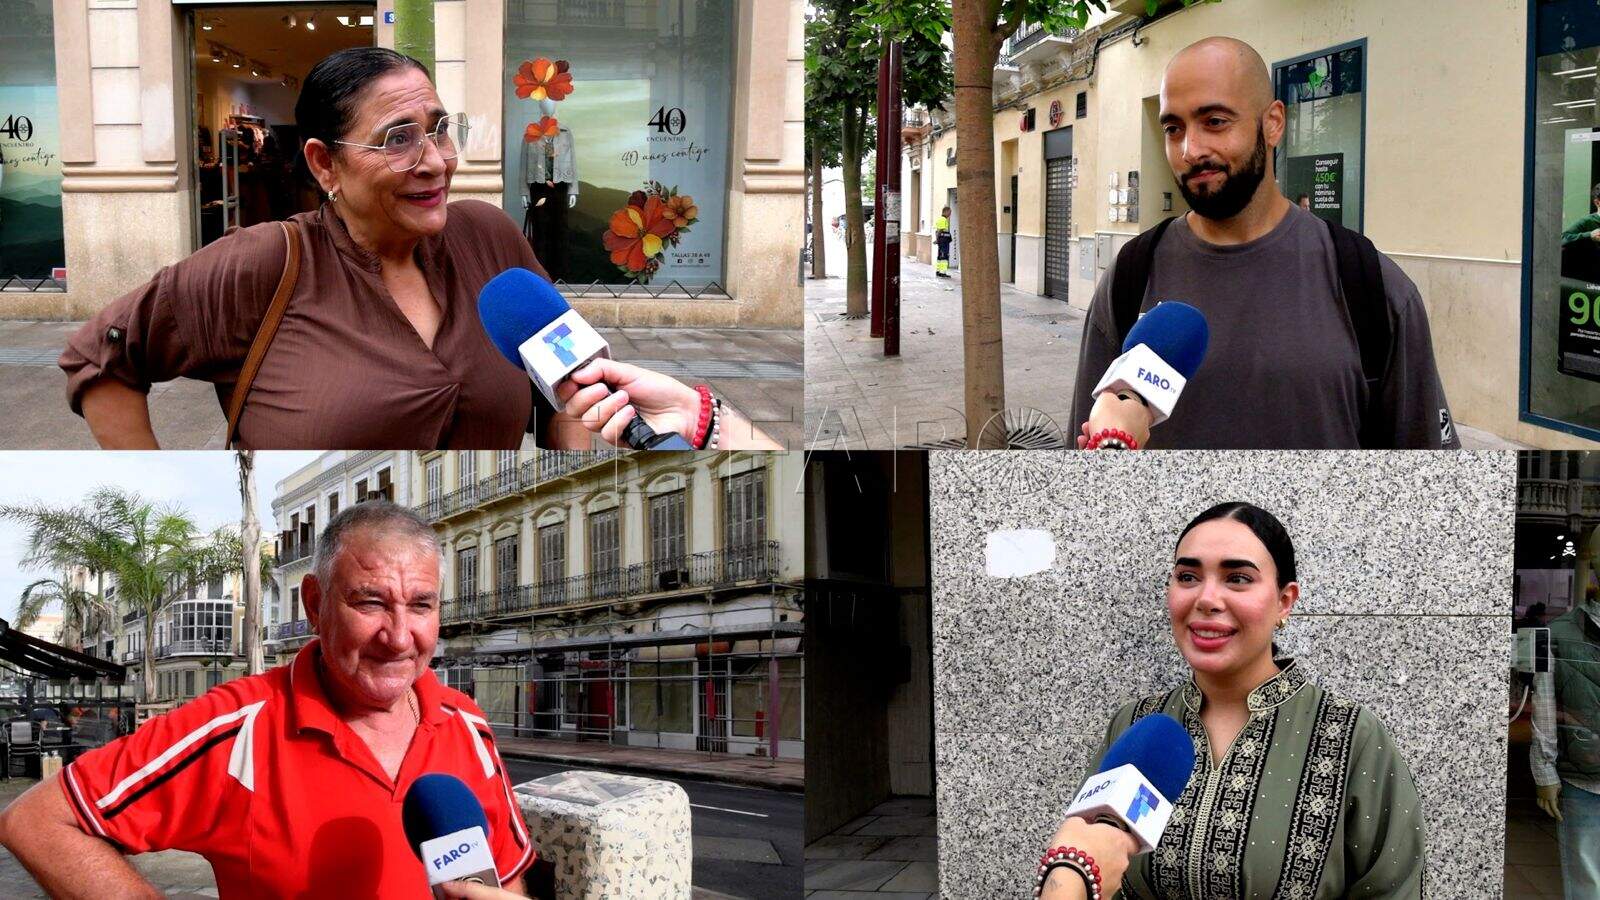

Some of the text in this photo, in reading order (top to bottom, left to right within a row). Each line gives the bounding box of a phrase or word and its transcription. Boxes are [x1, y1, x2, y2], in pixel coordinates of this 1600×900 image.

[0, 114, 33, 142] 40
[647, 105, 686, 135] 40
[620, 150, 639, 166] 40
[670, 142, 712, 162] contigo
[1315, 172, 1337, 183] 450€
[1137, 367, 1170, 390] FARO
[1078, 780, 1111, 803] FARO
[433, 843, 471, 870] FARO
